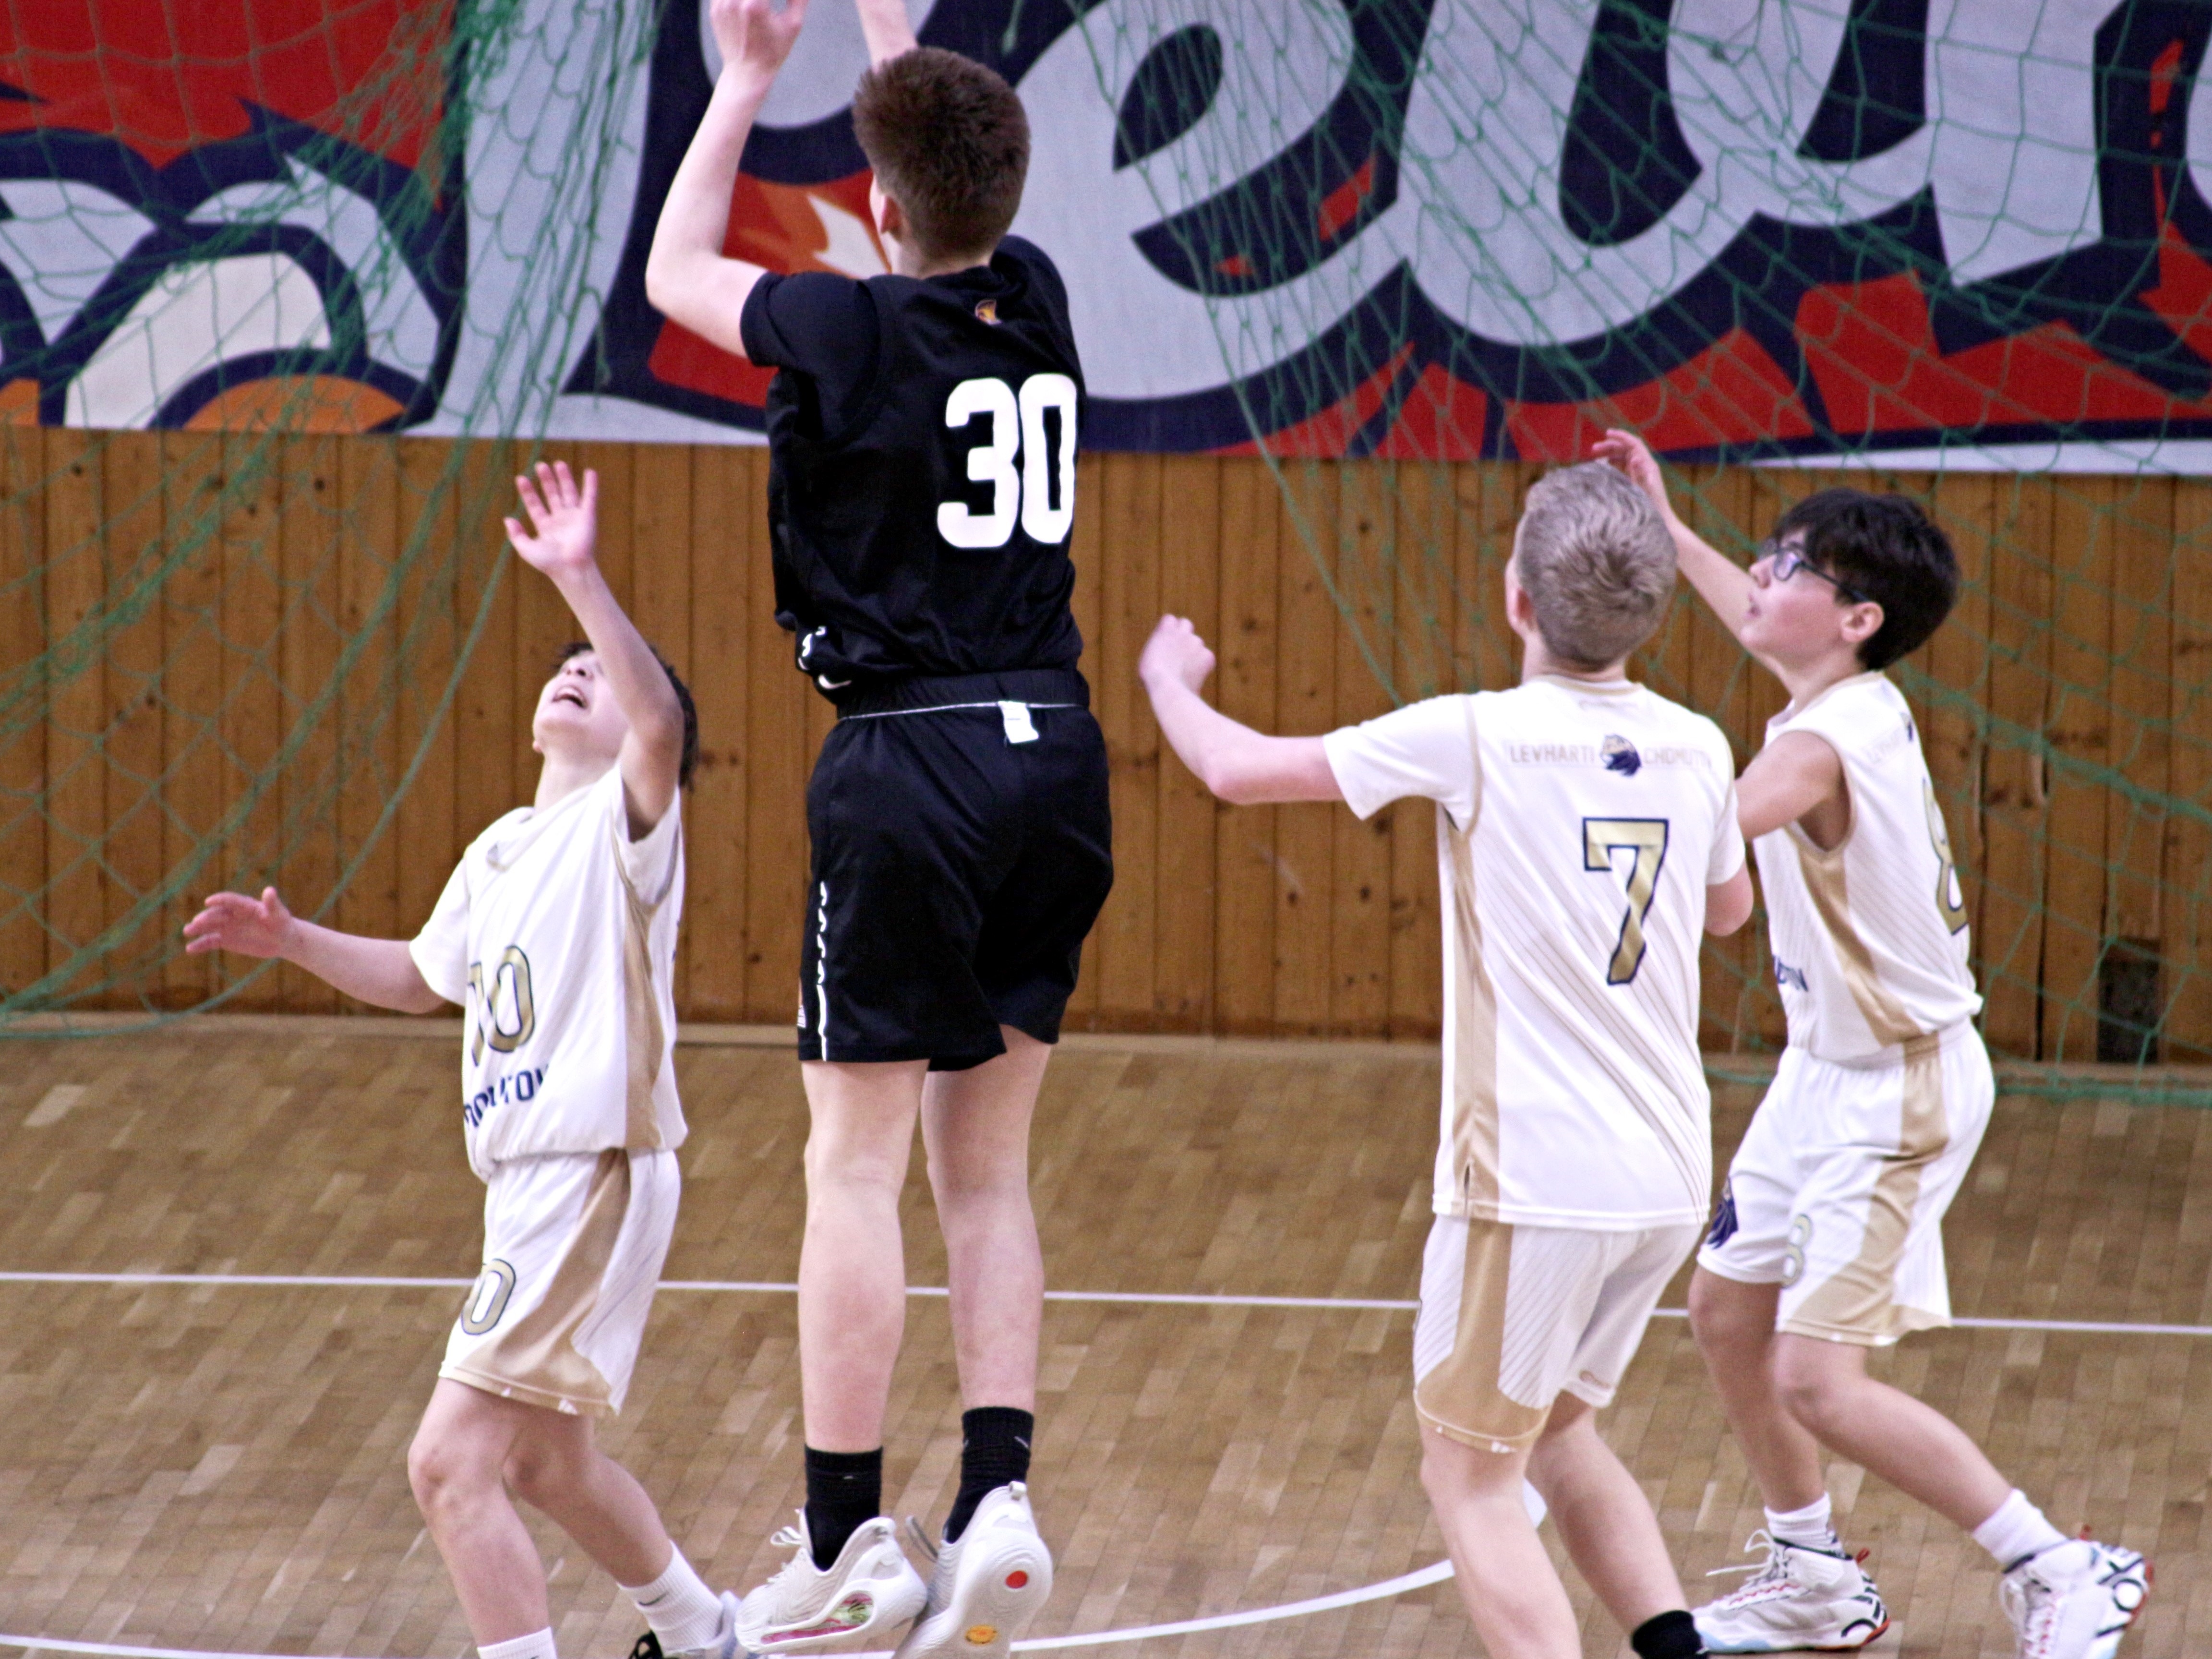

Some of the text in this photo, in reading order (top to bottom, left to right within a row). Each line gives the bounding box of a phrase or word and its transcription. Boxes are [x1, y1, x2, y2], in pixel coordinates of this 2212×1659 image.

[937, 373, 1077, 548] 30
[1509, 744, 1595, 764] LEVHARTI
[1582, 817, 1669, 986] 7
